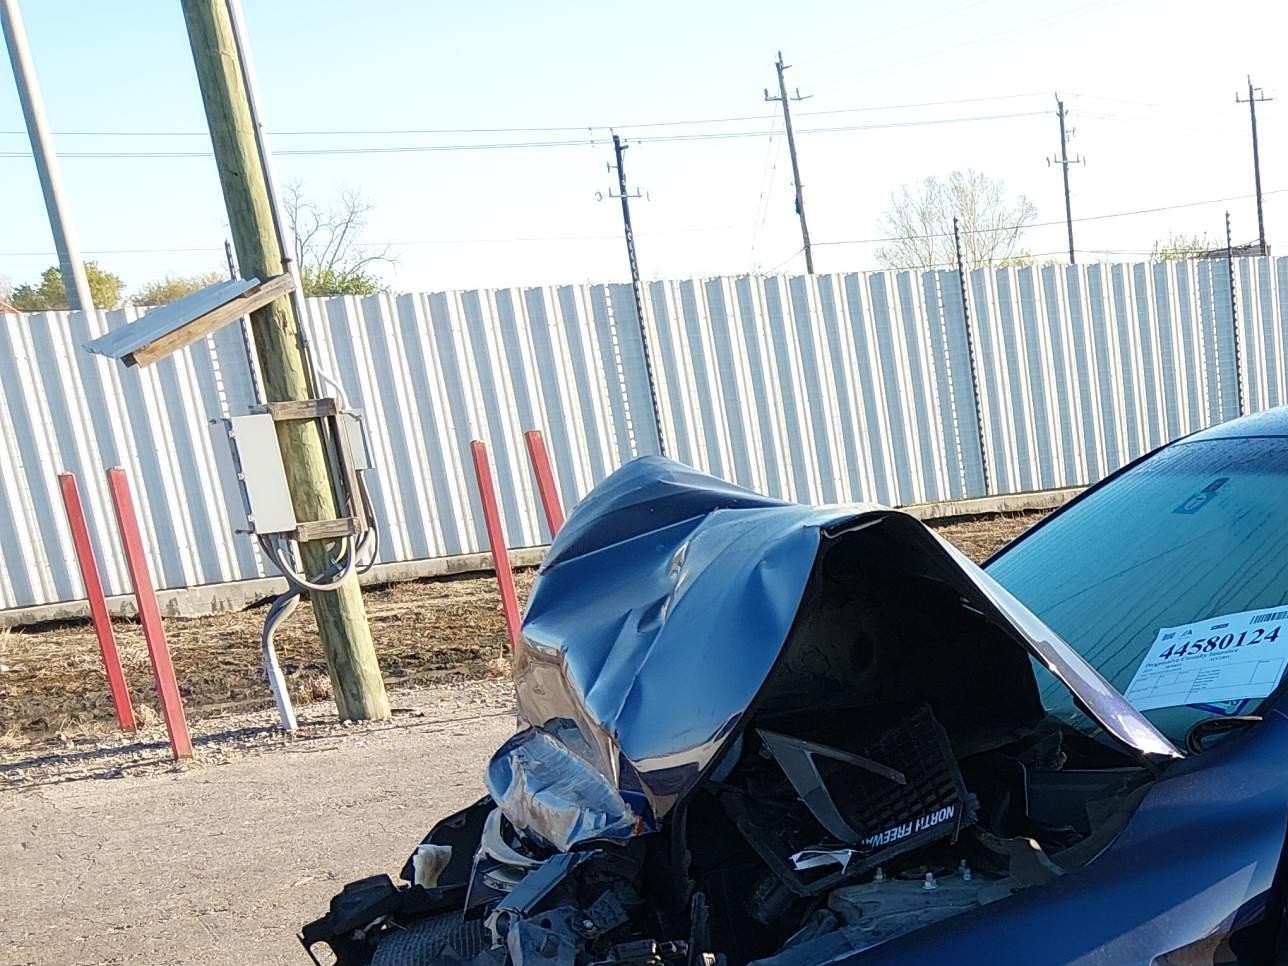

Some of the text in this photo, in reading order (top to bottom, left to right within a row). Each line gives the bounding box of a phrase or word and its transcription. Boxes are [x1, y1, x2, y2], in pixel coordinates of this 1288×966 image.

[1159, 626, 1282, 660] 44580124
[862, 804, 955, 848] NORTH FREEWA
